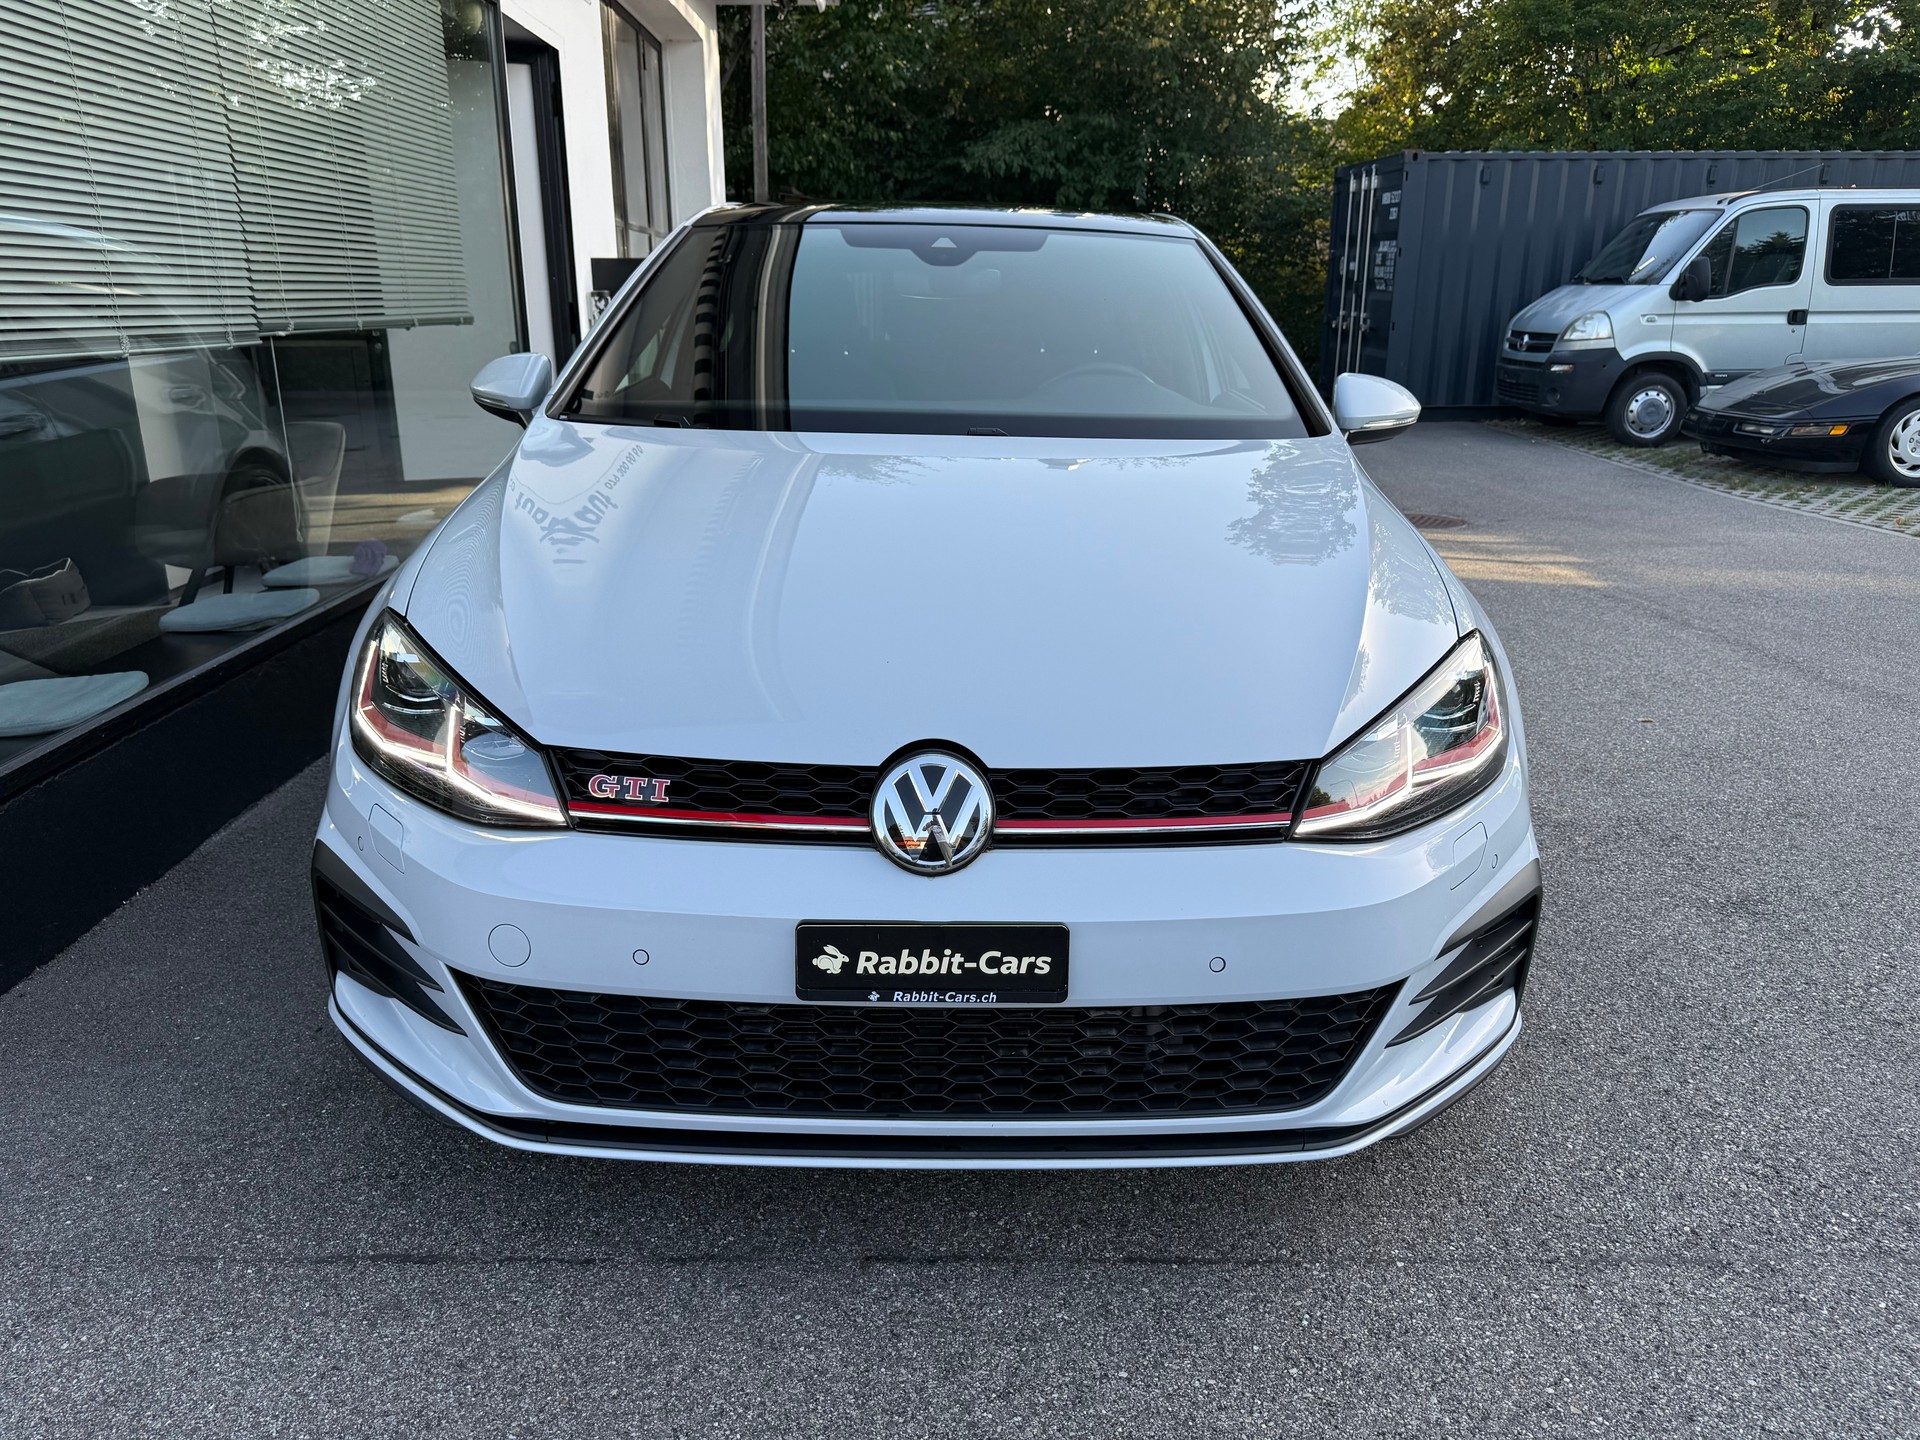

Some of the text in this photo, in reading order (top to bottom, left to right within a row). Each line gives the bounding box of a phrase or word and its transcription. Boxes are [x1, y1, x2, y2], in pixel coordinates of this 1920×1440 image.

[588, 774, 670, 802] GTI
[856, 949, 1052, 975] Rabbit-Cars
[893, 991, 997, 1003] Rabbit-Cars.ch
